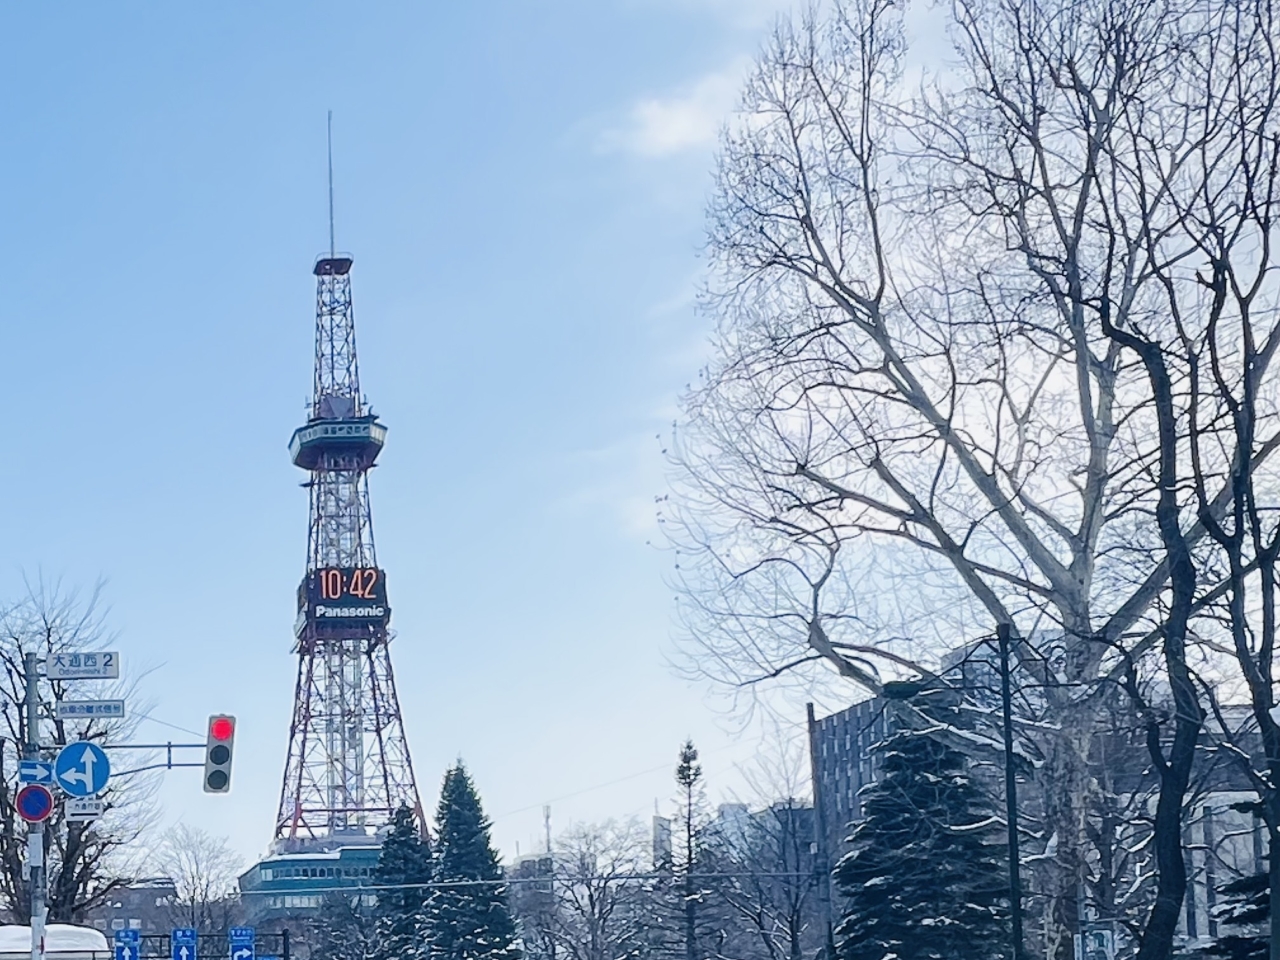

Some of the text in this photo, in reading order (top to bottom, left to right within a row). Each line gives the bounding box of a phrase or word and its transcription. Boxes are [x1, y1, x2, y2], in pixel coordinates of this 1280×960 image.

[319, 569, 377, 599] 10:42
[315, 604, 385, 618] Panasonic
[52, 653, 113, 668] 大通西 2
